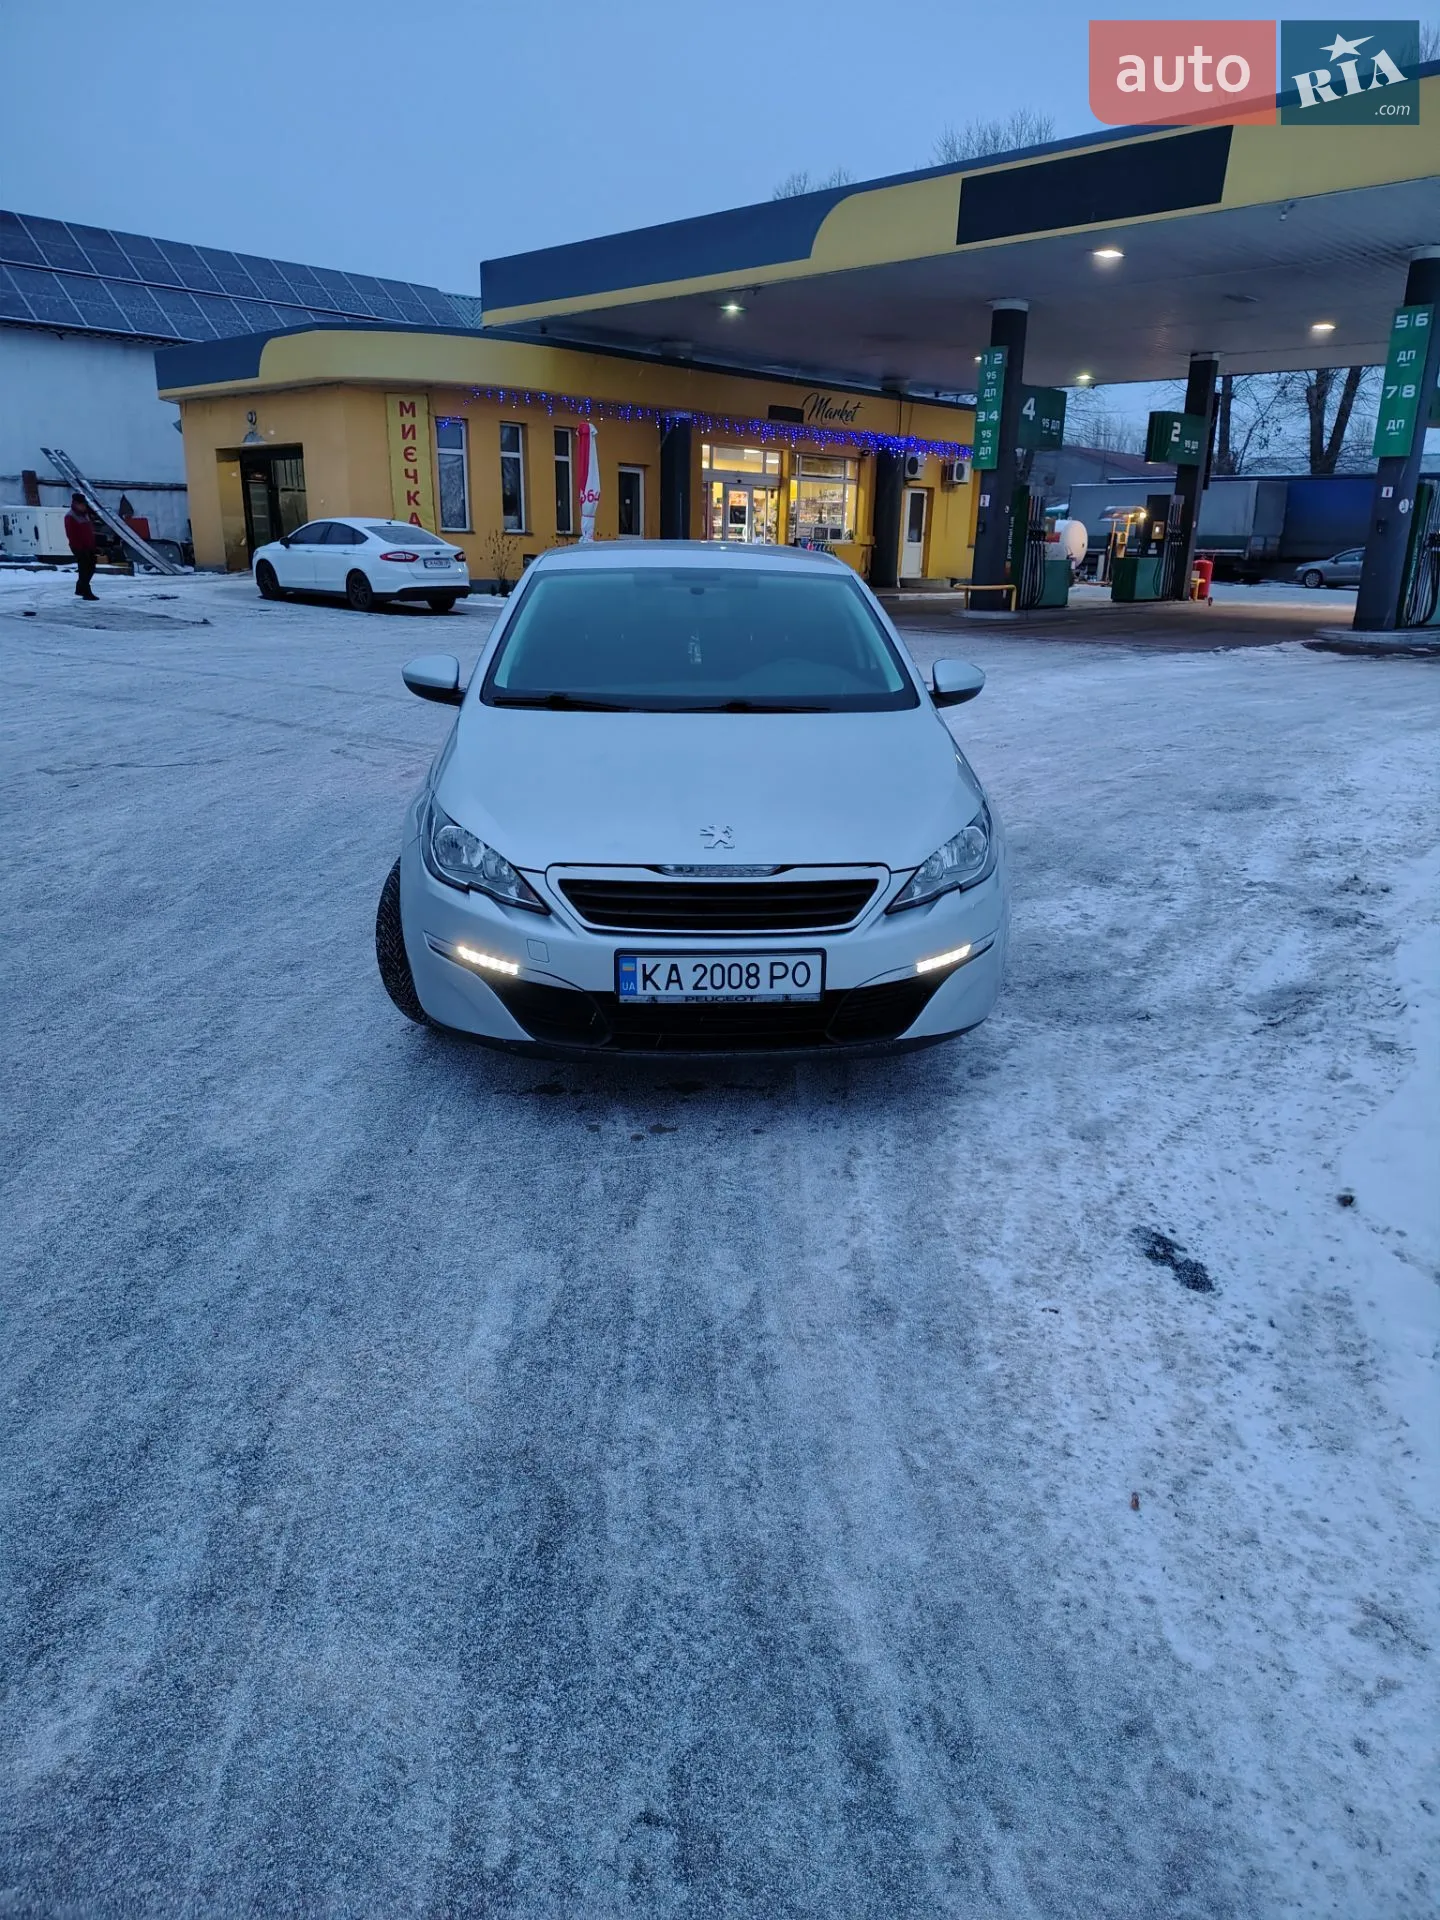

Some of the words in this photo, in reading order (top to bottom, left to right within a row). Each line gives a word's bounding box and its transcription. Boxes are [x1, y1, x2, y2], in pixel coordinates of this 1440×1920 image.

[1397, 350, 1416, 363] ДП
[986, 371, 997, 380] 95
[983, 388, 997, 398] ДП
[801, 392, 865, 426] Market
[1022, 397, 1036, 421] 4
[1041, 418, 1050, 428] 95
[1386, 419, 1405, 432] ДП
[981, 430, 992, 438] 95
[1170, 421, 1181, 443] 2
[978, 447, 992, 457] ДП
[398, 400, 423, 527] МИЄЧКА
[641, 963, 684, 991] KA
[692, 962, 760, 991] 2008
[769, 961, 811, 989] PO
[621, 982, 636, 992] UA
[684, 995, 755, 1003] PEUGEOT
